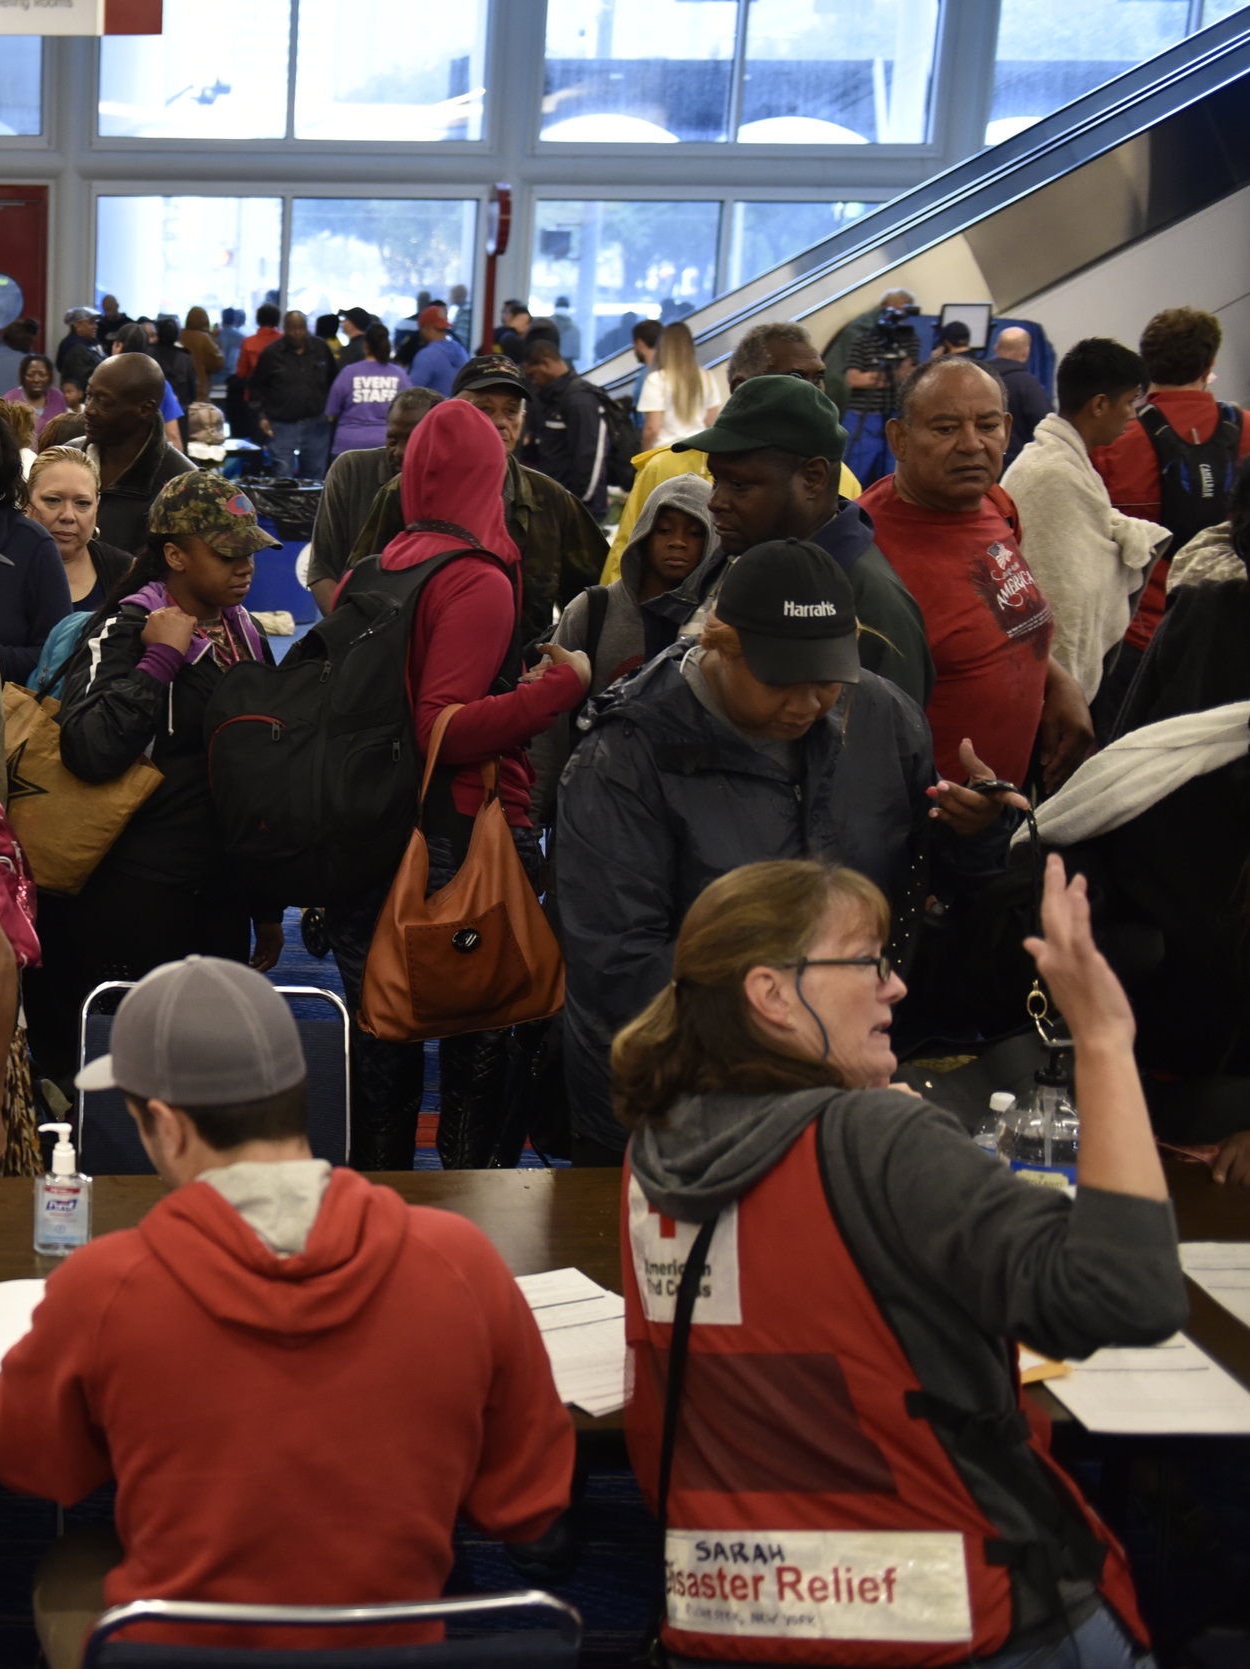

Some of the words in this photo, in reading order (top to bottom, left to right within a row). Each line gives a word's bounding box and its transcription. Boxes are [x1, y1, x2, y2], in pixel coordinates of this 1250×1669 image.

[352, 376, 400, 389] EVENT
[352, 388, 398, 403] STAFF
[695, 1540, 786, 1565] SARAH
[775, 1565, 897, 1605] Relief
